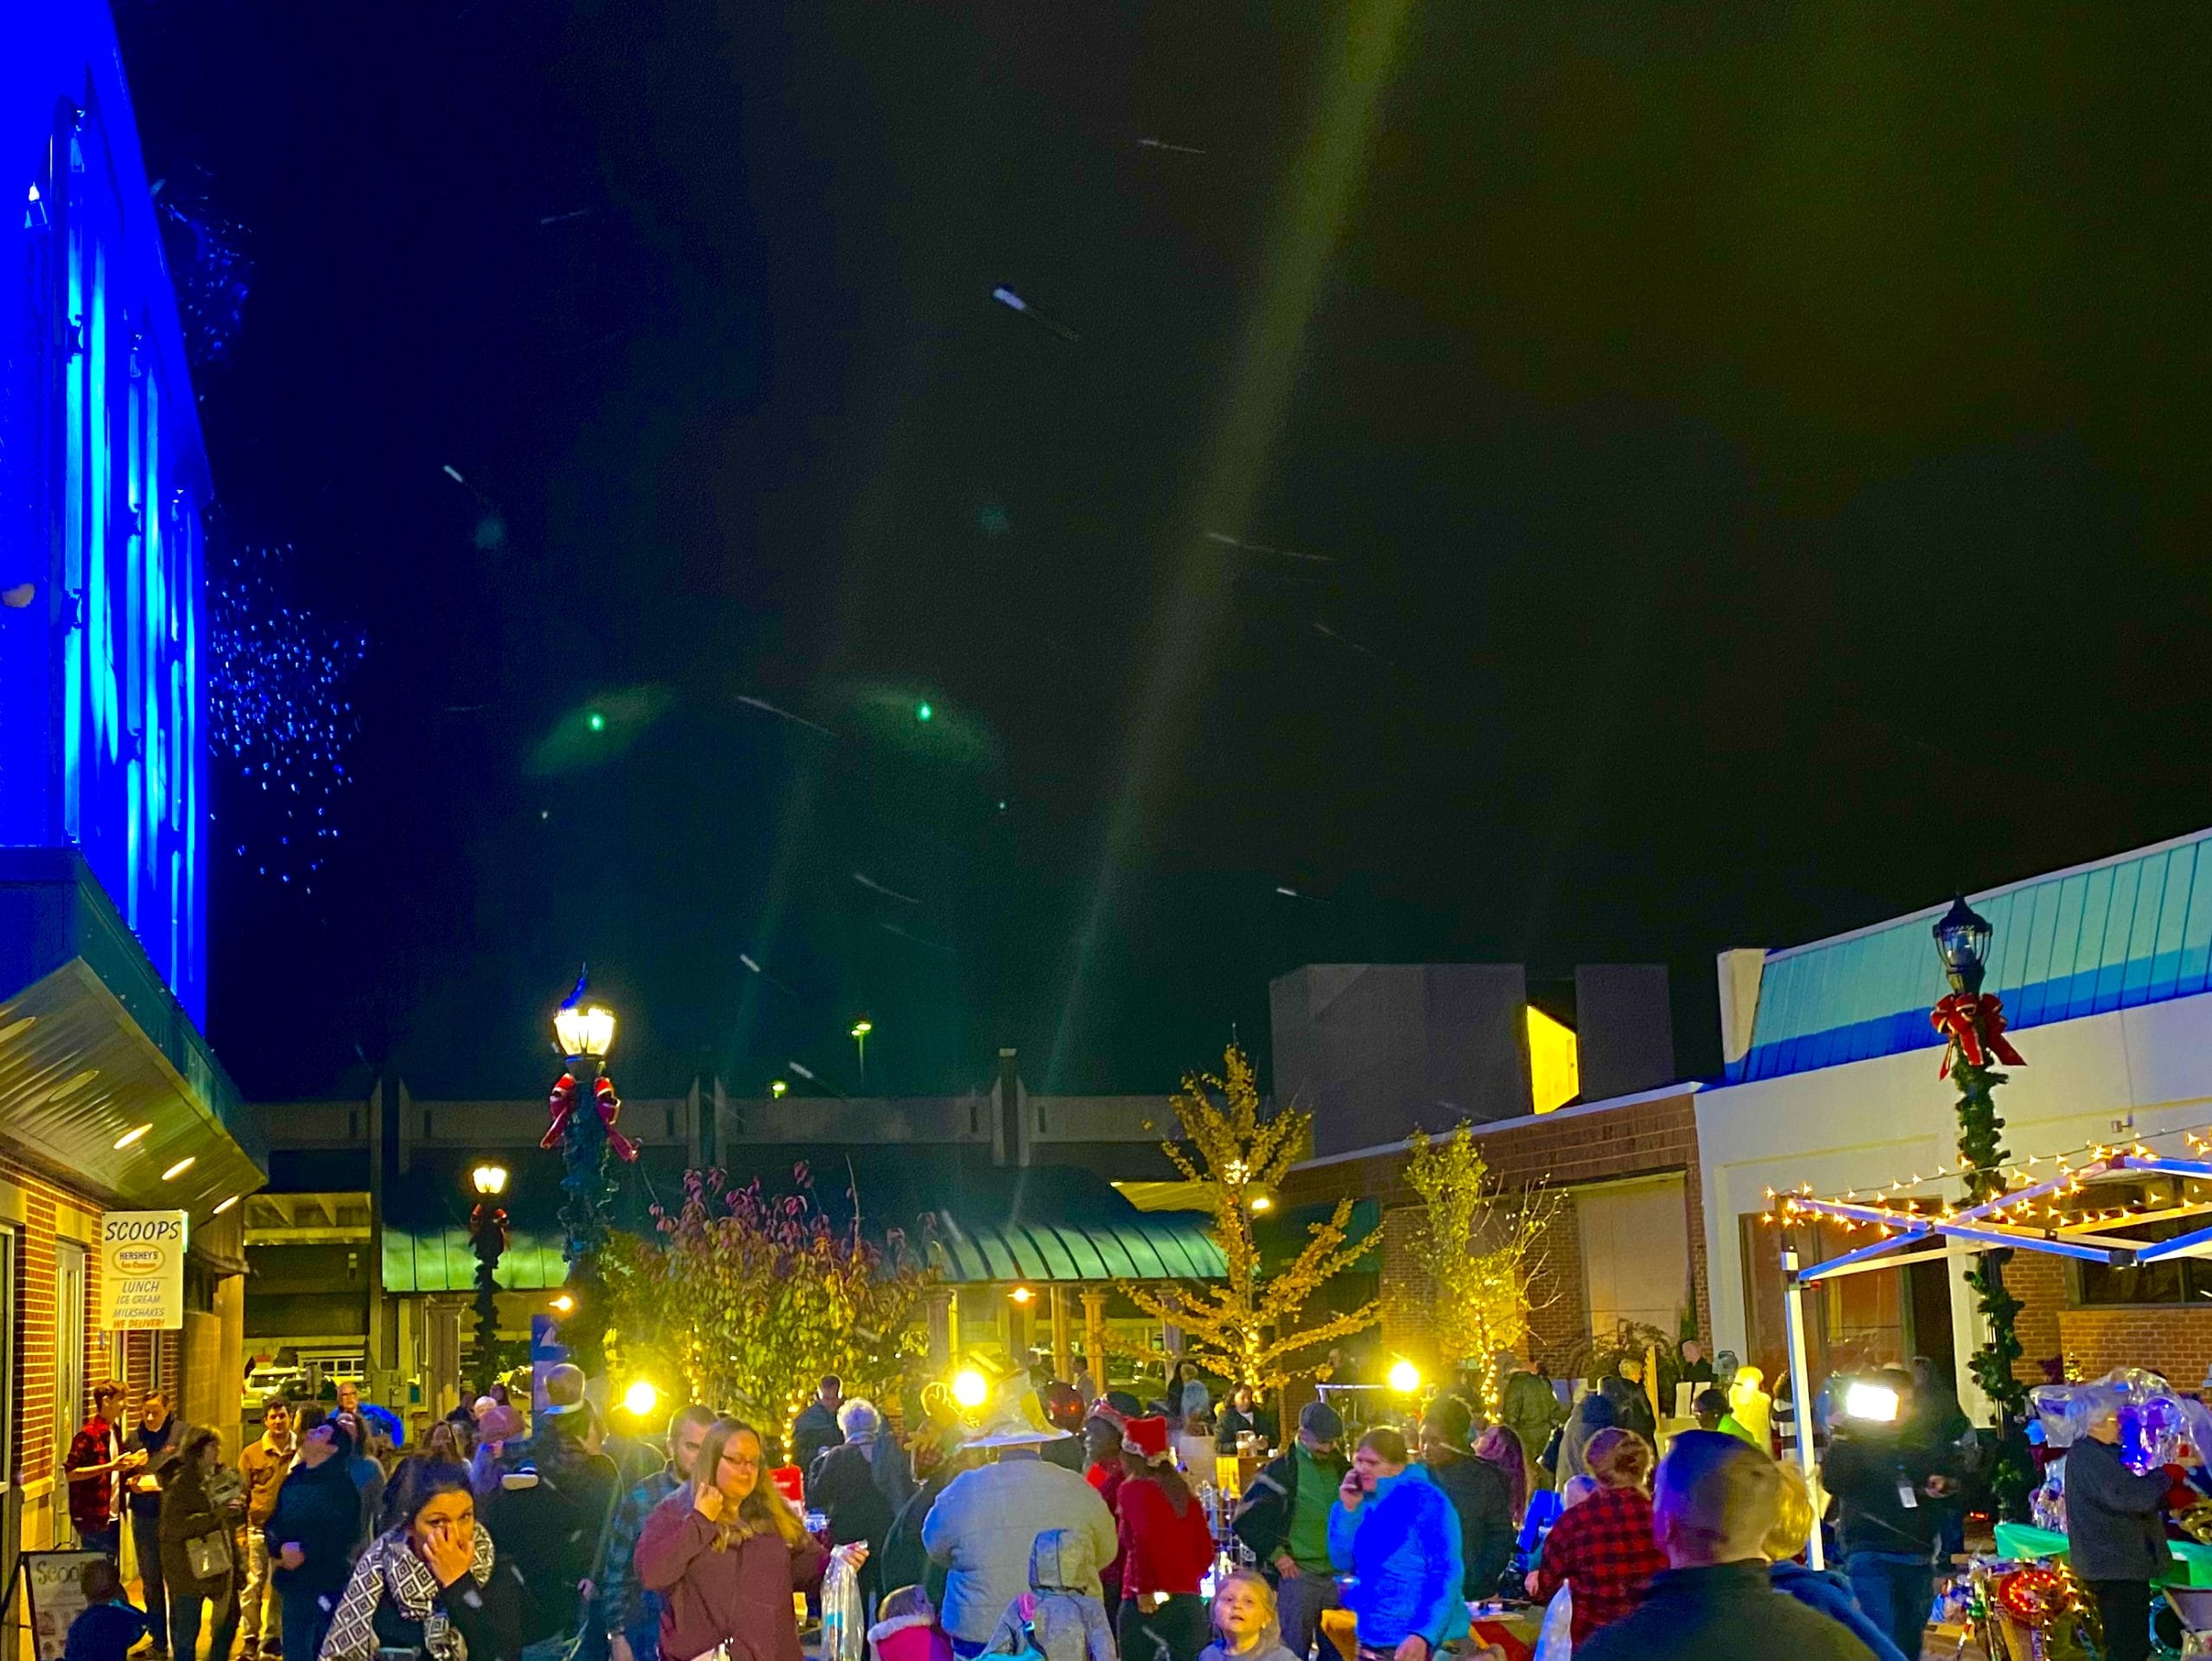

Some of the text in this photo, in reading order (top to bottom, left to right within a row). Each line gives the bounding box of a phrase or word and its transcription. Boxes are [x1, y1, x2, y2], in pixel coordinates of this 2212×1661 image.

[105, 1220, 181, 1241] SCOOPS
[122, 1280, 160, 1293] LUNCH
[116, 1295, 161, 1305] ICE CREAM
[112, 1308, 166, 1318] MILKSHAKES
[113, 1320, 126, 1328] WE
